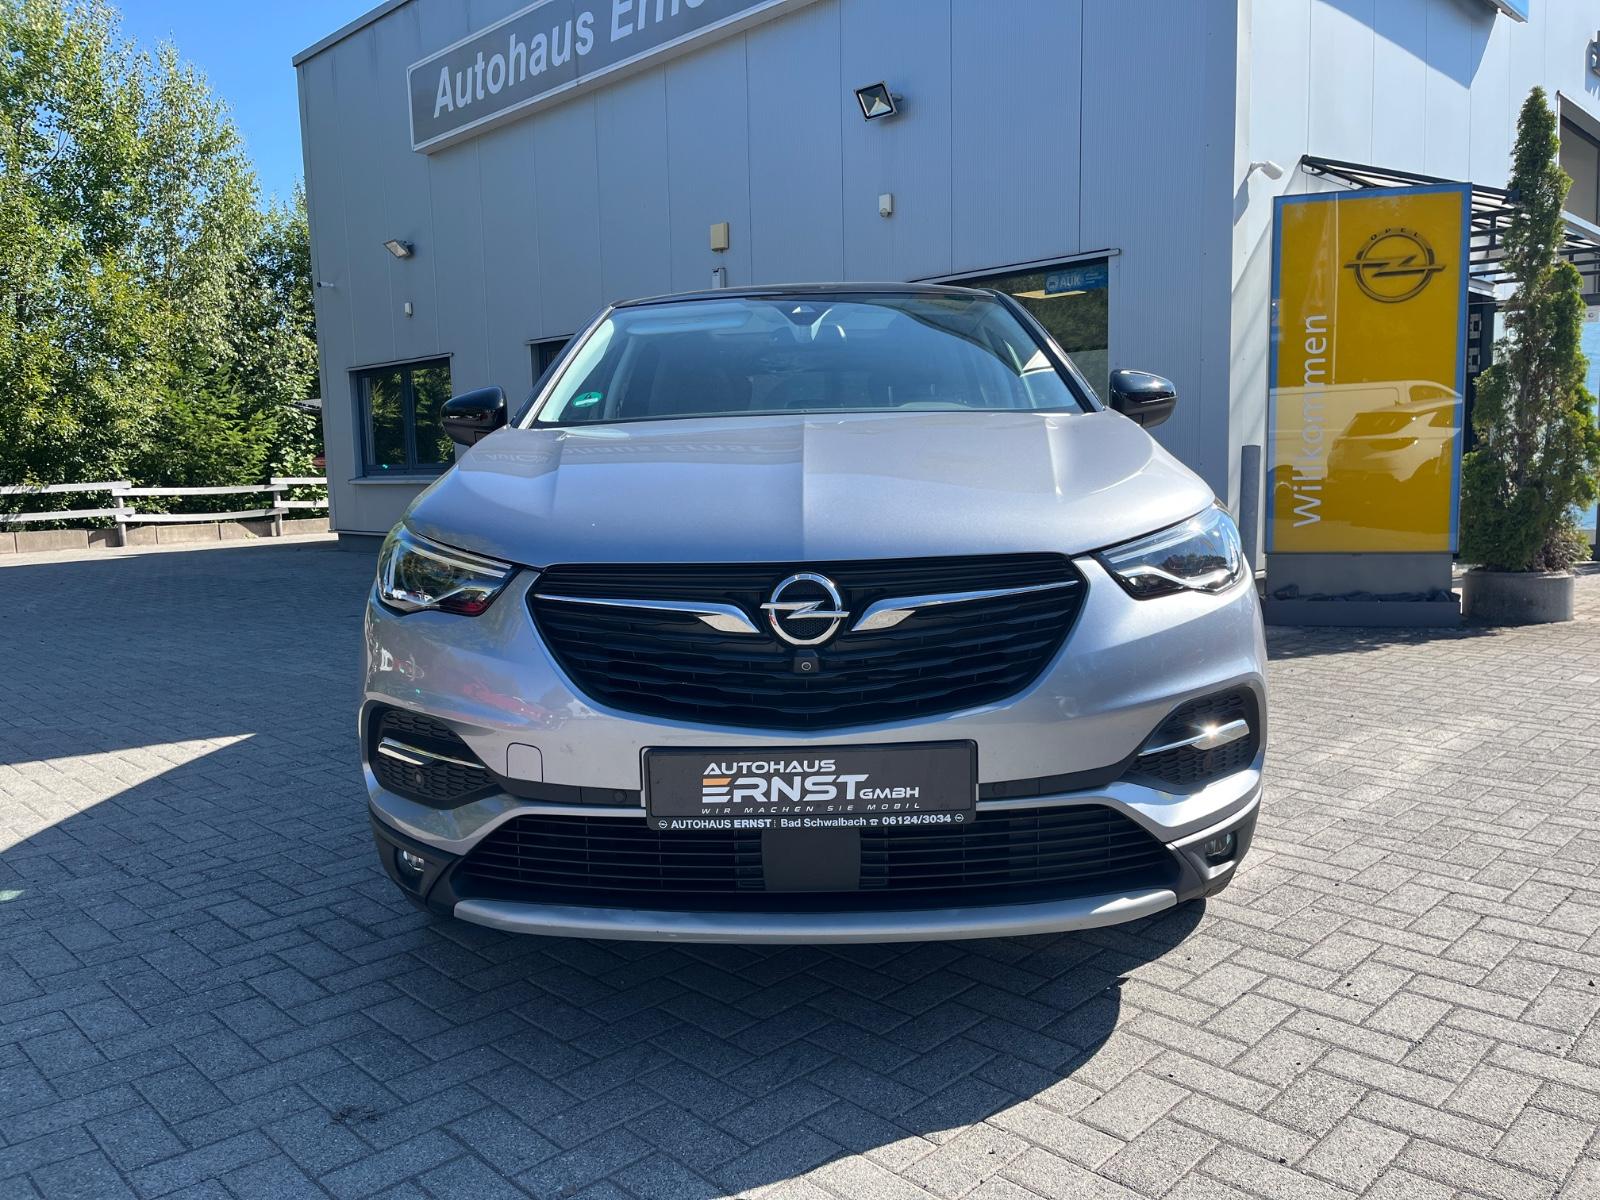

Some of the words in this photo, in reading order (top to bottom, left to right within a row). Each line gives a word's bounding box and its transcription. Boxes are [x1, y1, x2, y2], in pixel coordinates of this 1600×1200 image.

[433, 11, 595, 119] Autohaus
[610, 0, 704, 42] Ern
[1292, 313, 1328, 528] Willkommen
[703, 759, 836, 775] AUTOHAUS
[702, 774, 869, 803] ERNST
[744, 806, 814, 814] MACHEN
[827, 804, 854, 812] SIE
[867, 802, 920, 810] MOBIL
[671, 819, 731, 829] AUTOHAUS
[734, 819, 771, 828] ERNST
[781, 818, 801, 828] Bad
[804, 817, 866, 828] Schwalbach
[882, 814, 951, 825] 06124/3034
